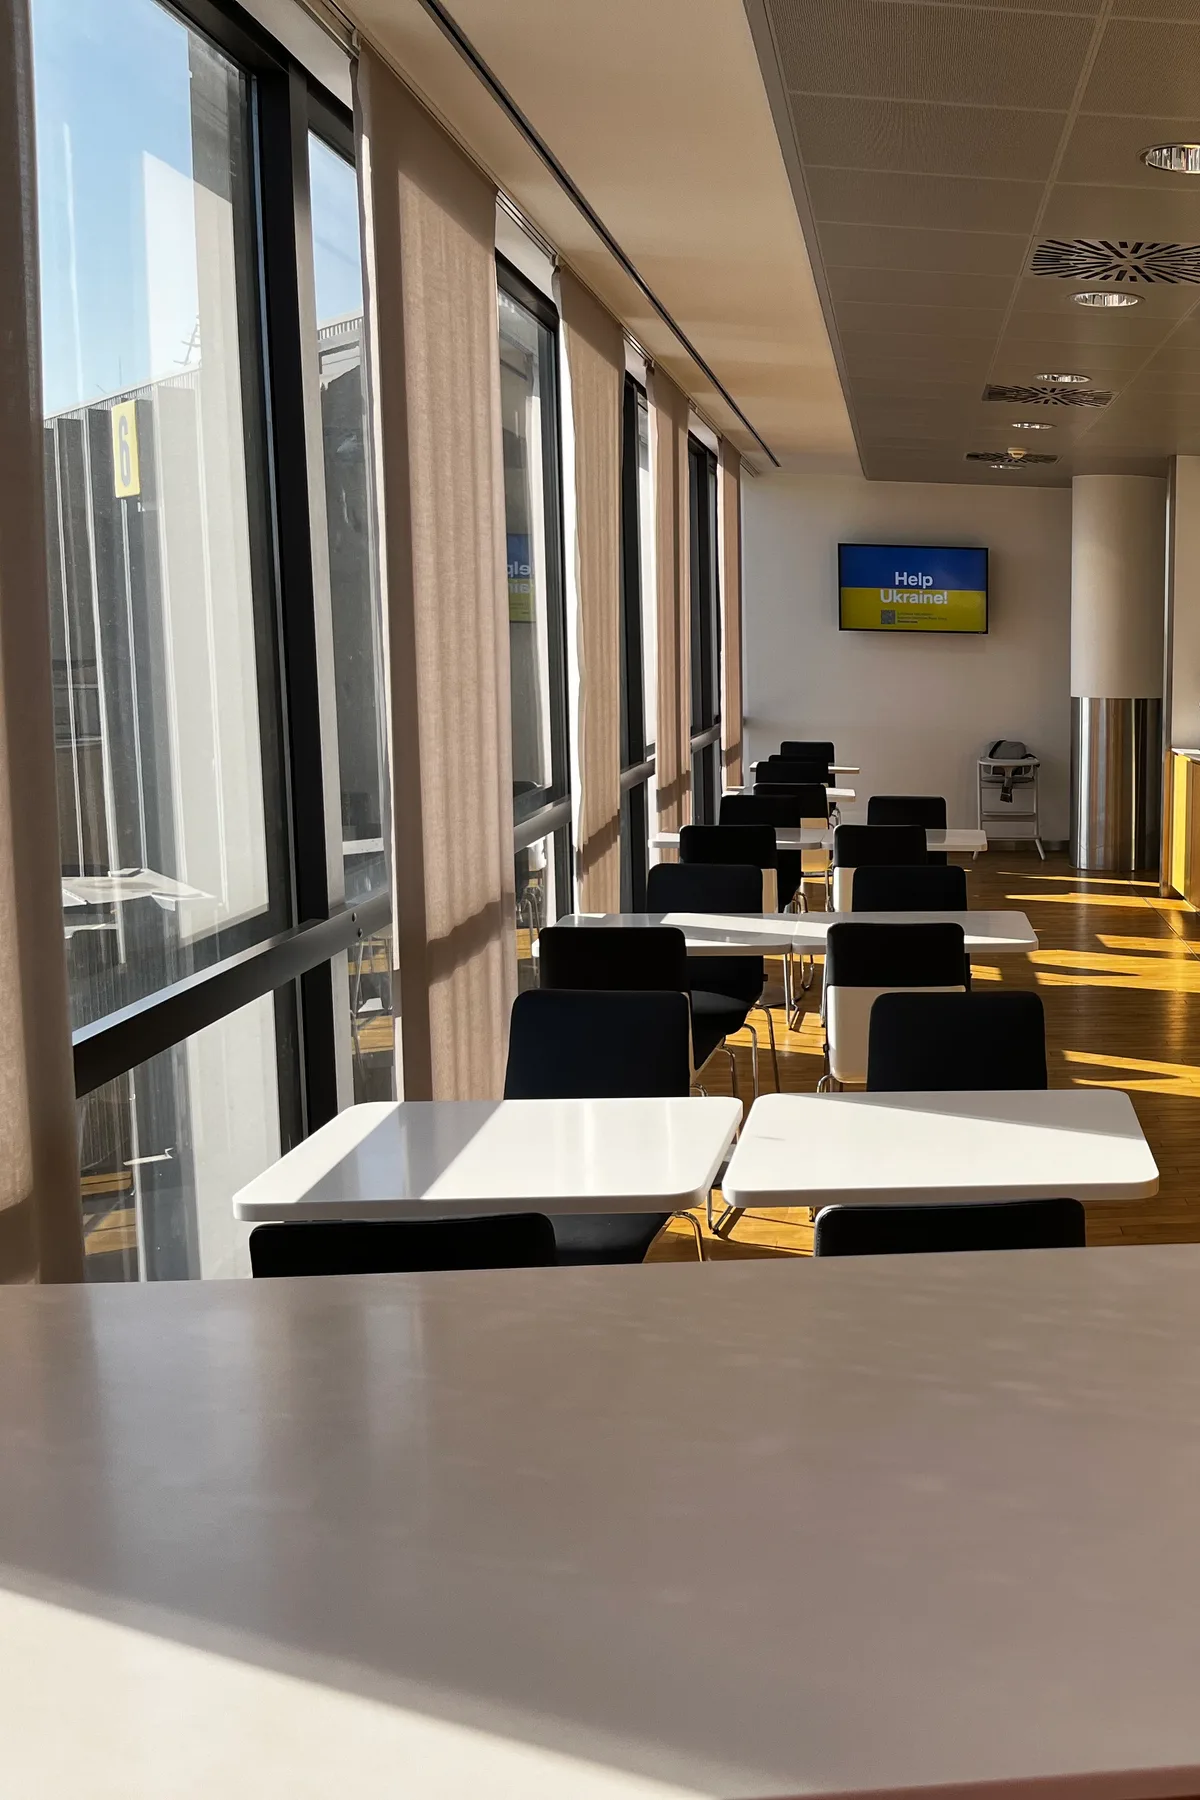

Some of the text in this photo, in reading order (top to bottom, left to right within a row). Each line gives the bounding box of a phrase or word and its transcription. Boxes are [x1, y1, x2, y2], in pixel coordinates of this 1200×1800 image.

[118, 415, 131, 487] 6
[894, 571, 933, 589] Help
[880, 588, 948, 605] Ukraine!
